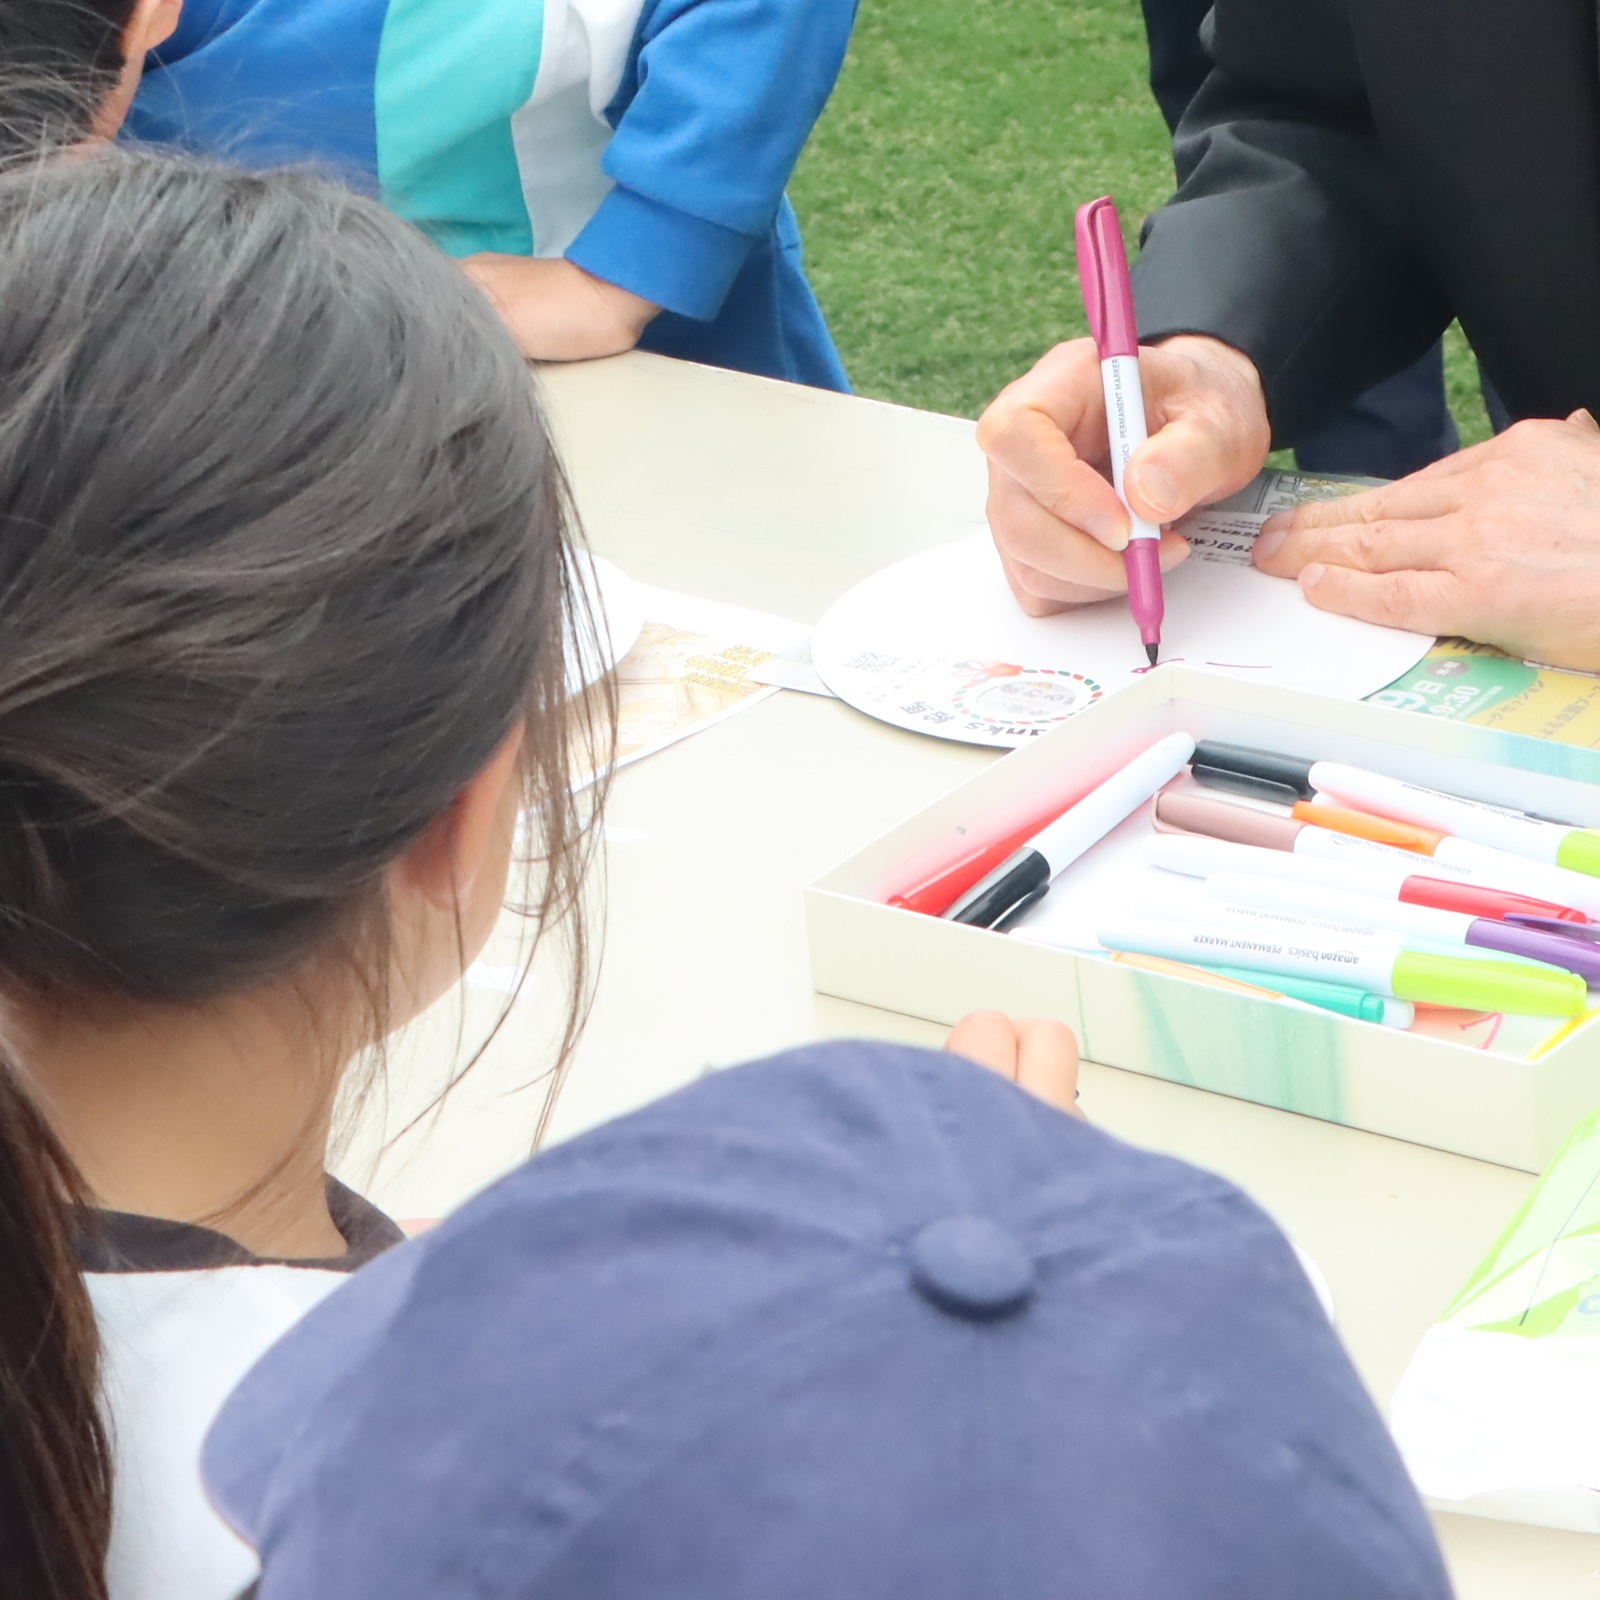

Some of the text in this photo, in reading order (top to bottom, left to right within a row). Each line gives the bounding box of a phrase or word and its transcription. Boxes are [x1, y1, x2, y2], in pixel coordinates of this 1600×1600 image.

[1111, 358, 1121, 391] MARKER
[1114, 392, 1125, 440] PERMANENT
[962, 721, 1047, 737] anks
[1193, 934, 1360, 965] amazon basics PERMANENT MARKER
